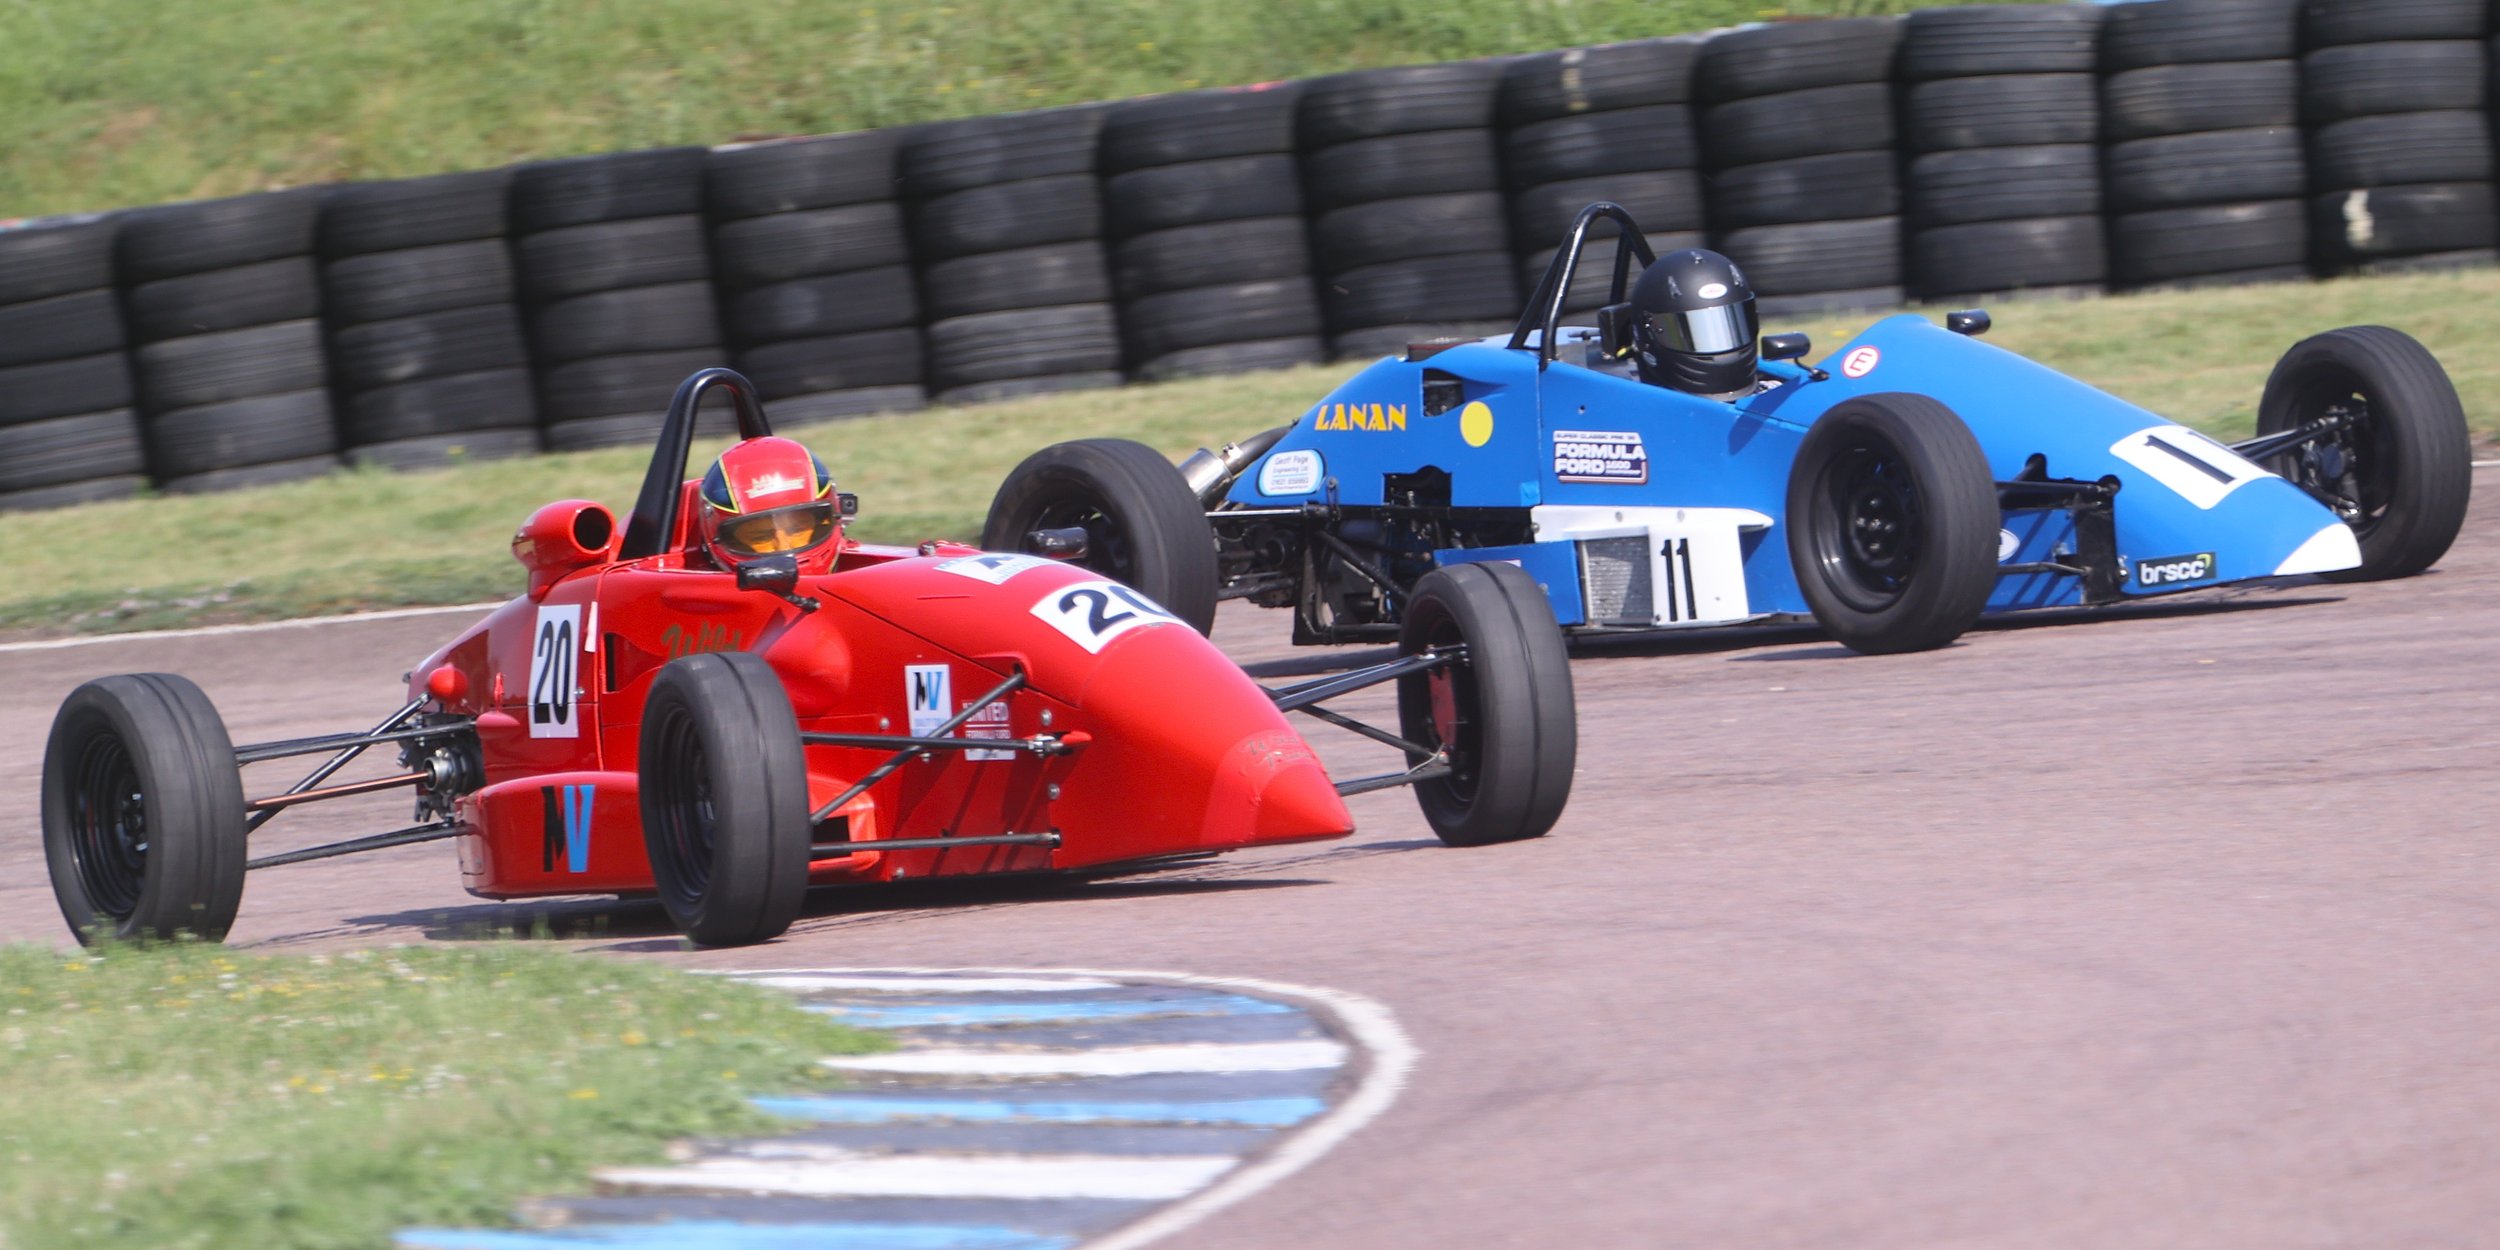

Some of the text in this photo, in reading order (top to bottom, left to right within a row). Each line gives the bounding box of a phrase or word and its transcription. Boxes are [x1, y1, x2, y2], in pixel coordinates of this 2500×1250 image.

[1848, 351, 1873, 373] E
[1313, 403, 1407, 431] LANAN
[1555, 443, 1647, 460] FORMULA
[1555, 458, 1605, 475] FORD
[1661, 537, 1697, 622] 11
[2140, 561, 2206, 586] brscc
[1058, 585, 1180, 636] 20
[534, 619, 571, 725] 20
